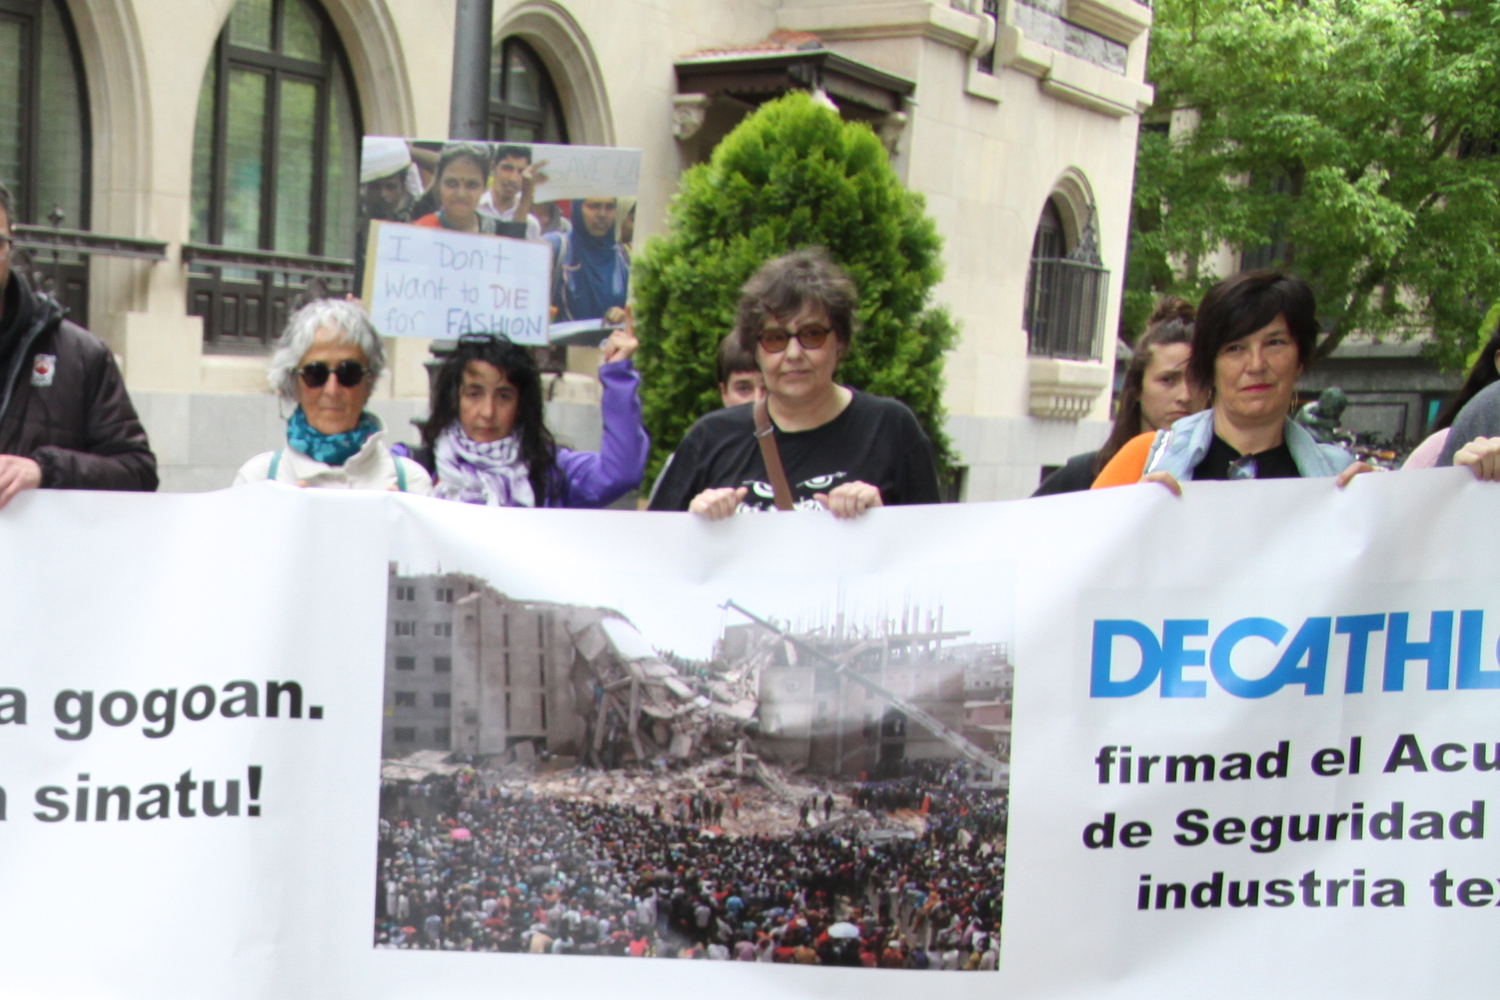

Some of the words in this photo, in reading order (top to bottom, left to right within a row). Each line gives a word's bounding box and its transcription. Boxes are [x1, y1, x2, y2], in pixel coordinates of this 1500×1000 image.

[388, 235, 411, 262] I
[386, 308, 426, 332] for
[445, 308, 543, 336] FASHION
[460, 282, 480, 304] to
[488, 285, 530, 310] DIE
[1089, 609, 1500, 700] DECATHL
[53, 678, 325, 742] gogoan.
[1095, 740, 1290, 785] firmad
[1310, 736, 1363, 777] el
[1382, 733, 1500, 774] Acu
[32, 764, 263, 823] sinatu!
[1082, 812, 1153, 850] de
[1173, 799, 1486, 854] Seguridad
[1137, 868, 1406, 911] industria
[1429, 868, 1500, 908] te
